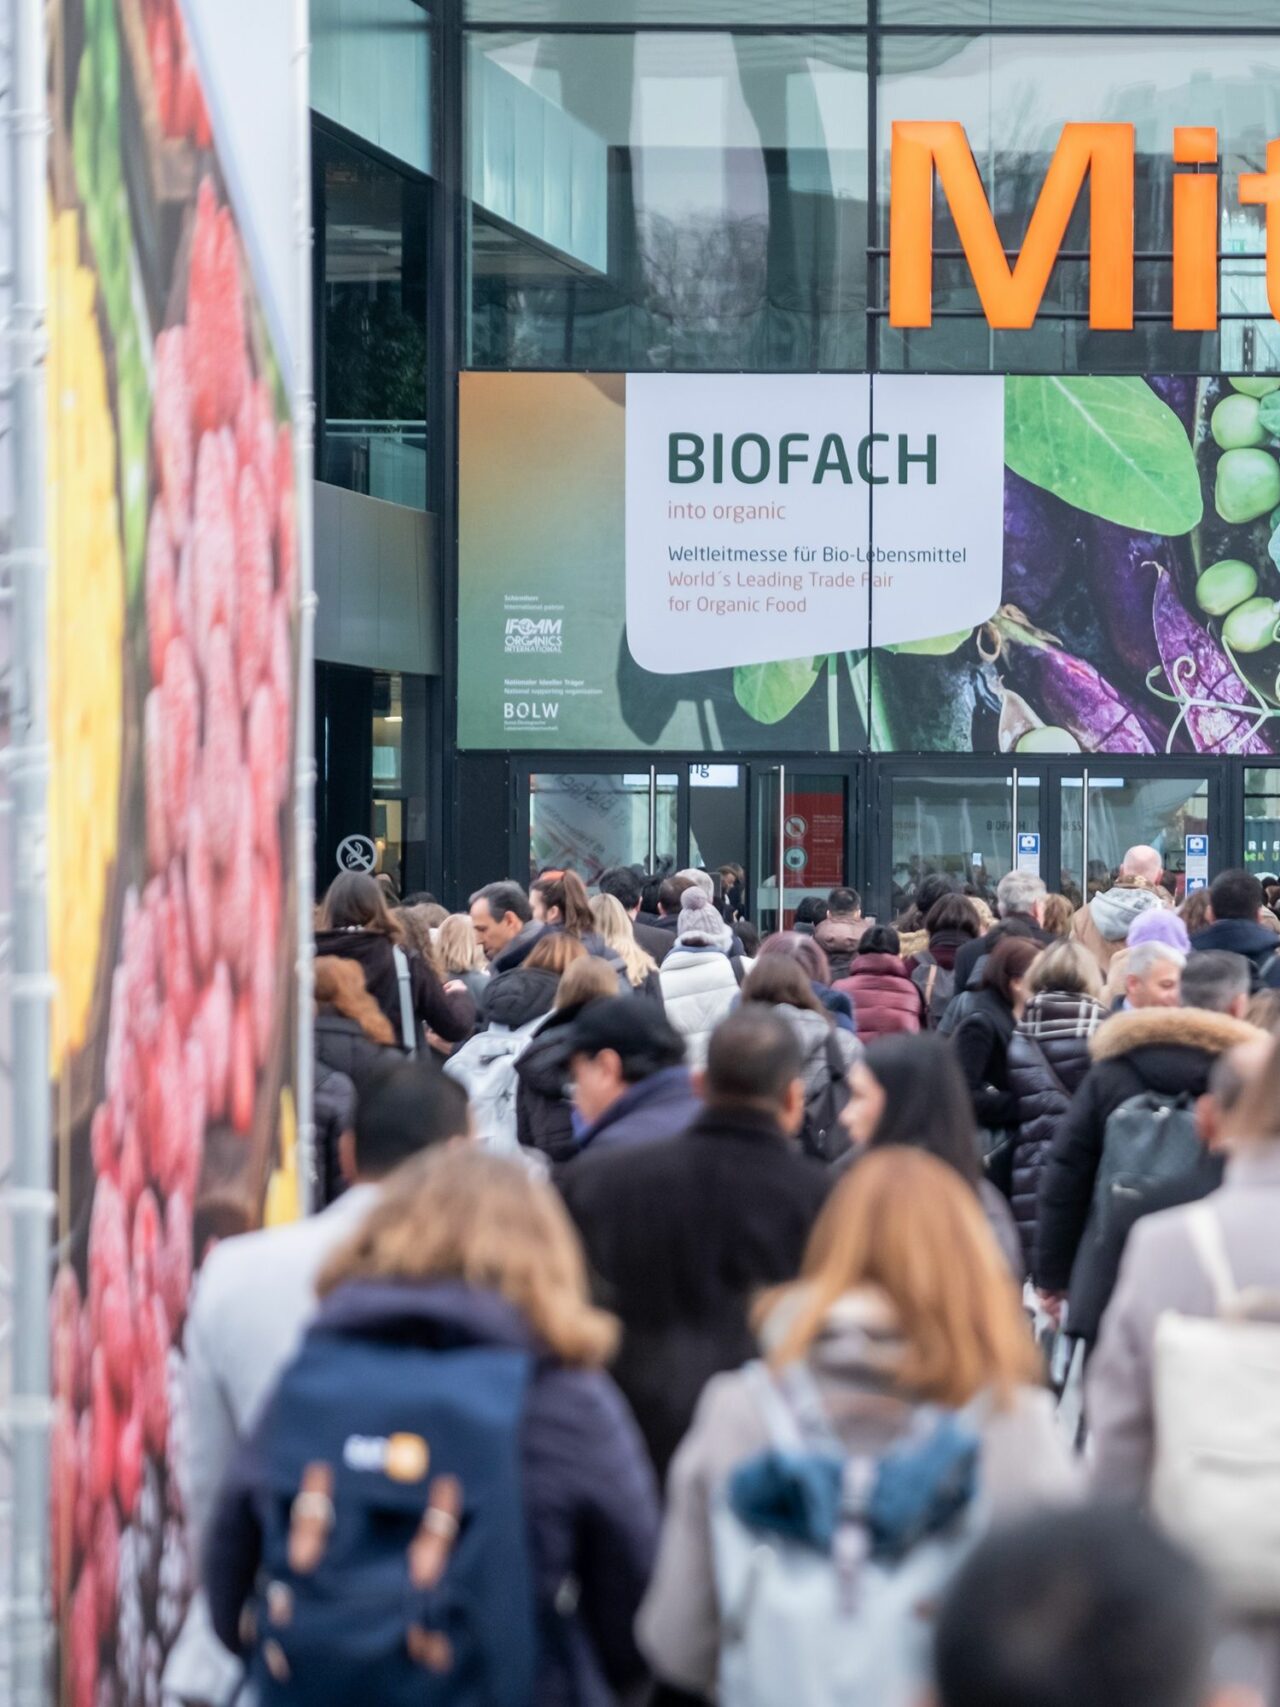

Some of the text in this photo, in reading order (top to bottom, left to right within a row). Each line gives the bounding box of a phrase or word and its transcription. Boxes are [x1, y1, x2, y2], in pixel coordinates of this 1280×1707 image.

[668, 432, 938, 485] BIOFACH
[668, 501, 786, 523] into organic
[668, 546, 967, 564] Weltleitmesse für Bio-Lebensmittel
[737, 571, 803, 591] Leading
[809, 571, 856, 588] Trade
[861, 572, 894, 588] Fair
[669, 597, 807, 616] for Organic Food
[505, 618, 562, 635] IFOAM
[505, 635, 562, 646] ORGANICS
